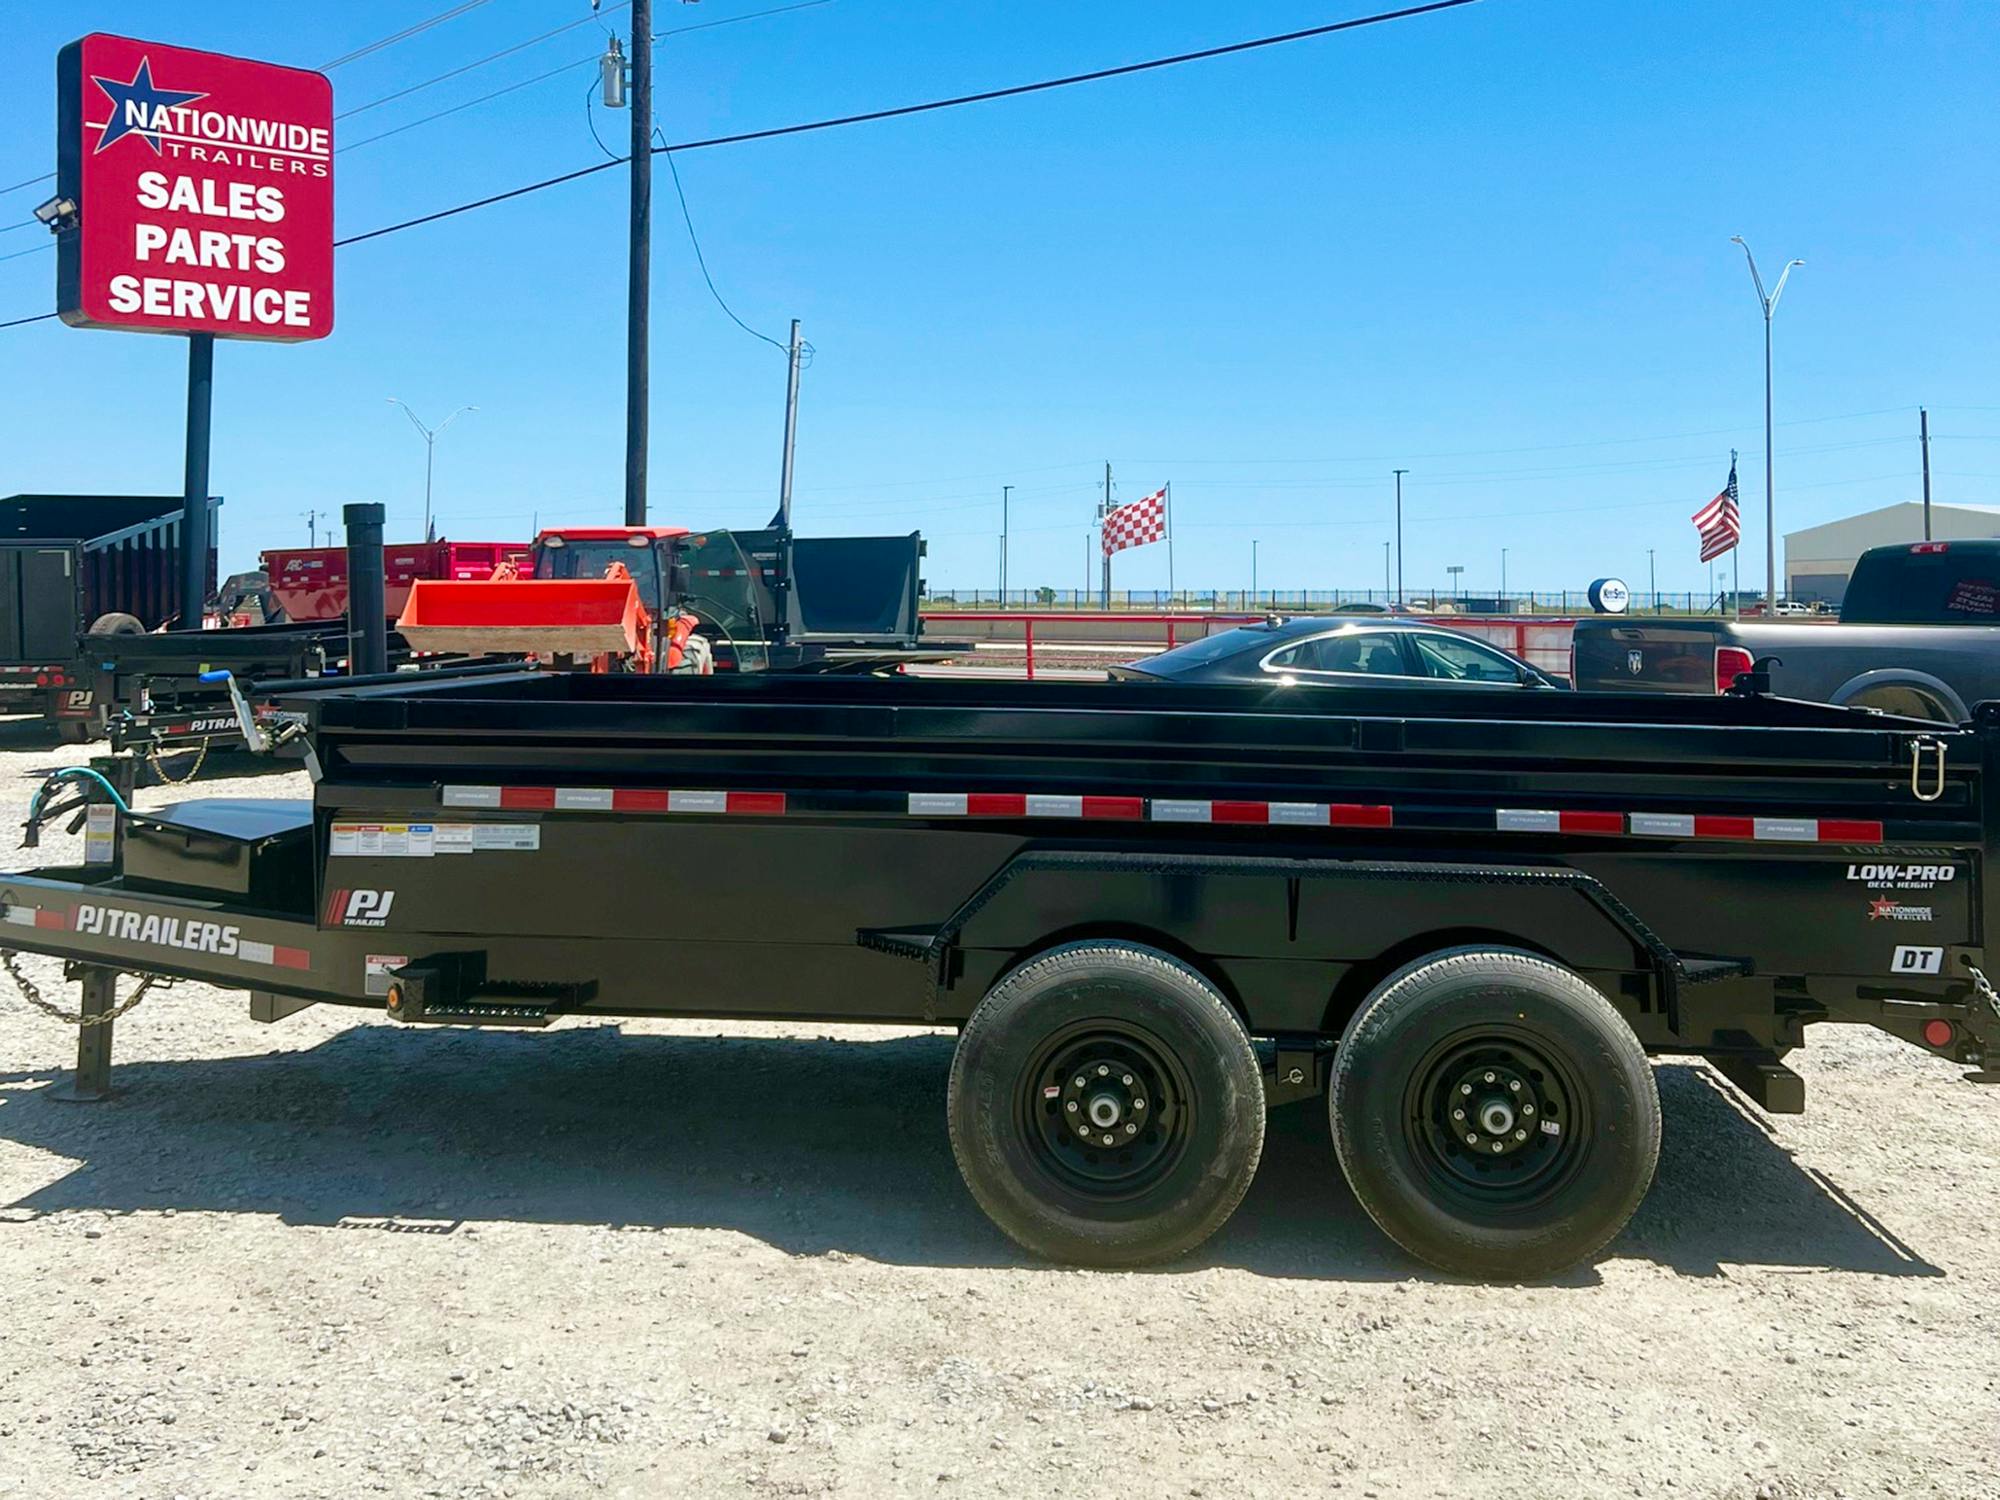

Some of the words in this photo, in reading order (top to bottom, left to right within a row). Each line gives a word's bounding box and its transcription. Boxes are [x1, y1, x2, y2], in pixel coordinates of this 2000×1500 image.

[124, 99, 330, 155] NATIONWIDE
[166, 141, 328, 178] TRAILERS
[136, 171, 286, 223] SALES
[135, 223, 286, 274] PARTS
[108, 274, 311, 327] SERVICE
[69, 690, 94, 706] PJ
[190, 720, 208, 732] PJ
[1846, 864, 1956, 881] LOW-PRO
[1867, 881, 1894, 889] DECK
[1896, 881, 1935, 889] HEIGHT
[345, 889, 395, 918] PJ
[1879, 906, 1932, 914] NATIONWIDE
[76, 904, 106, 935] PJ
[106, 908, 241, 956] TRAILERS
[344, 918, 386, 926] TRAILERS
[1901, 950, 1934, 969] DT
